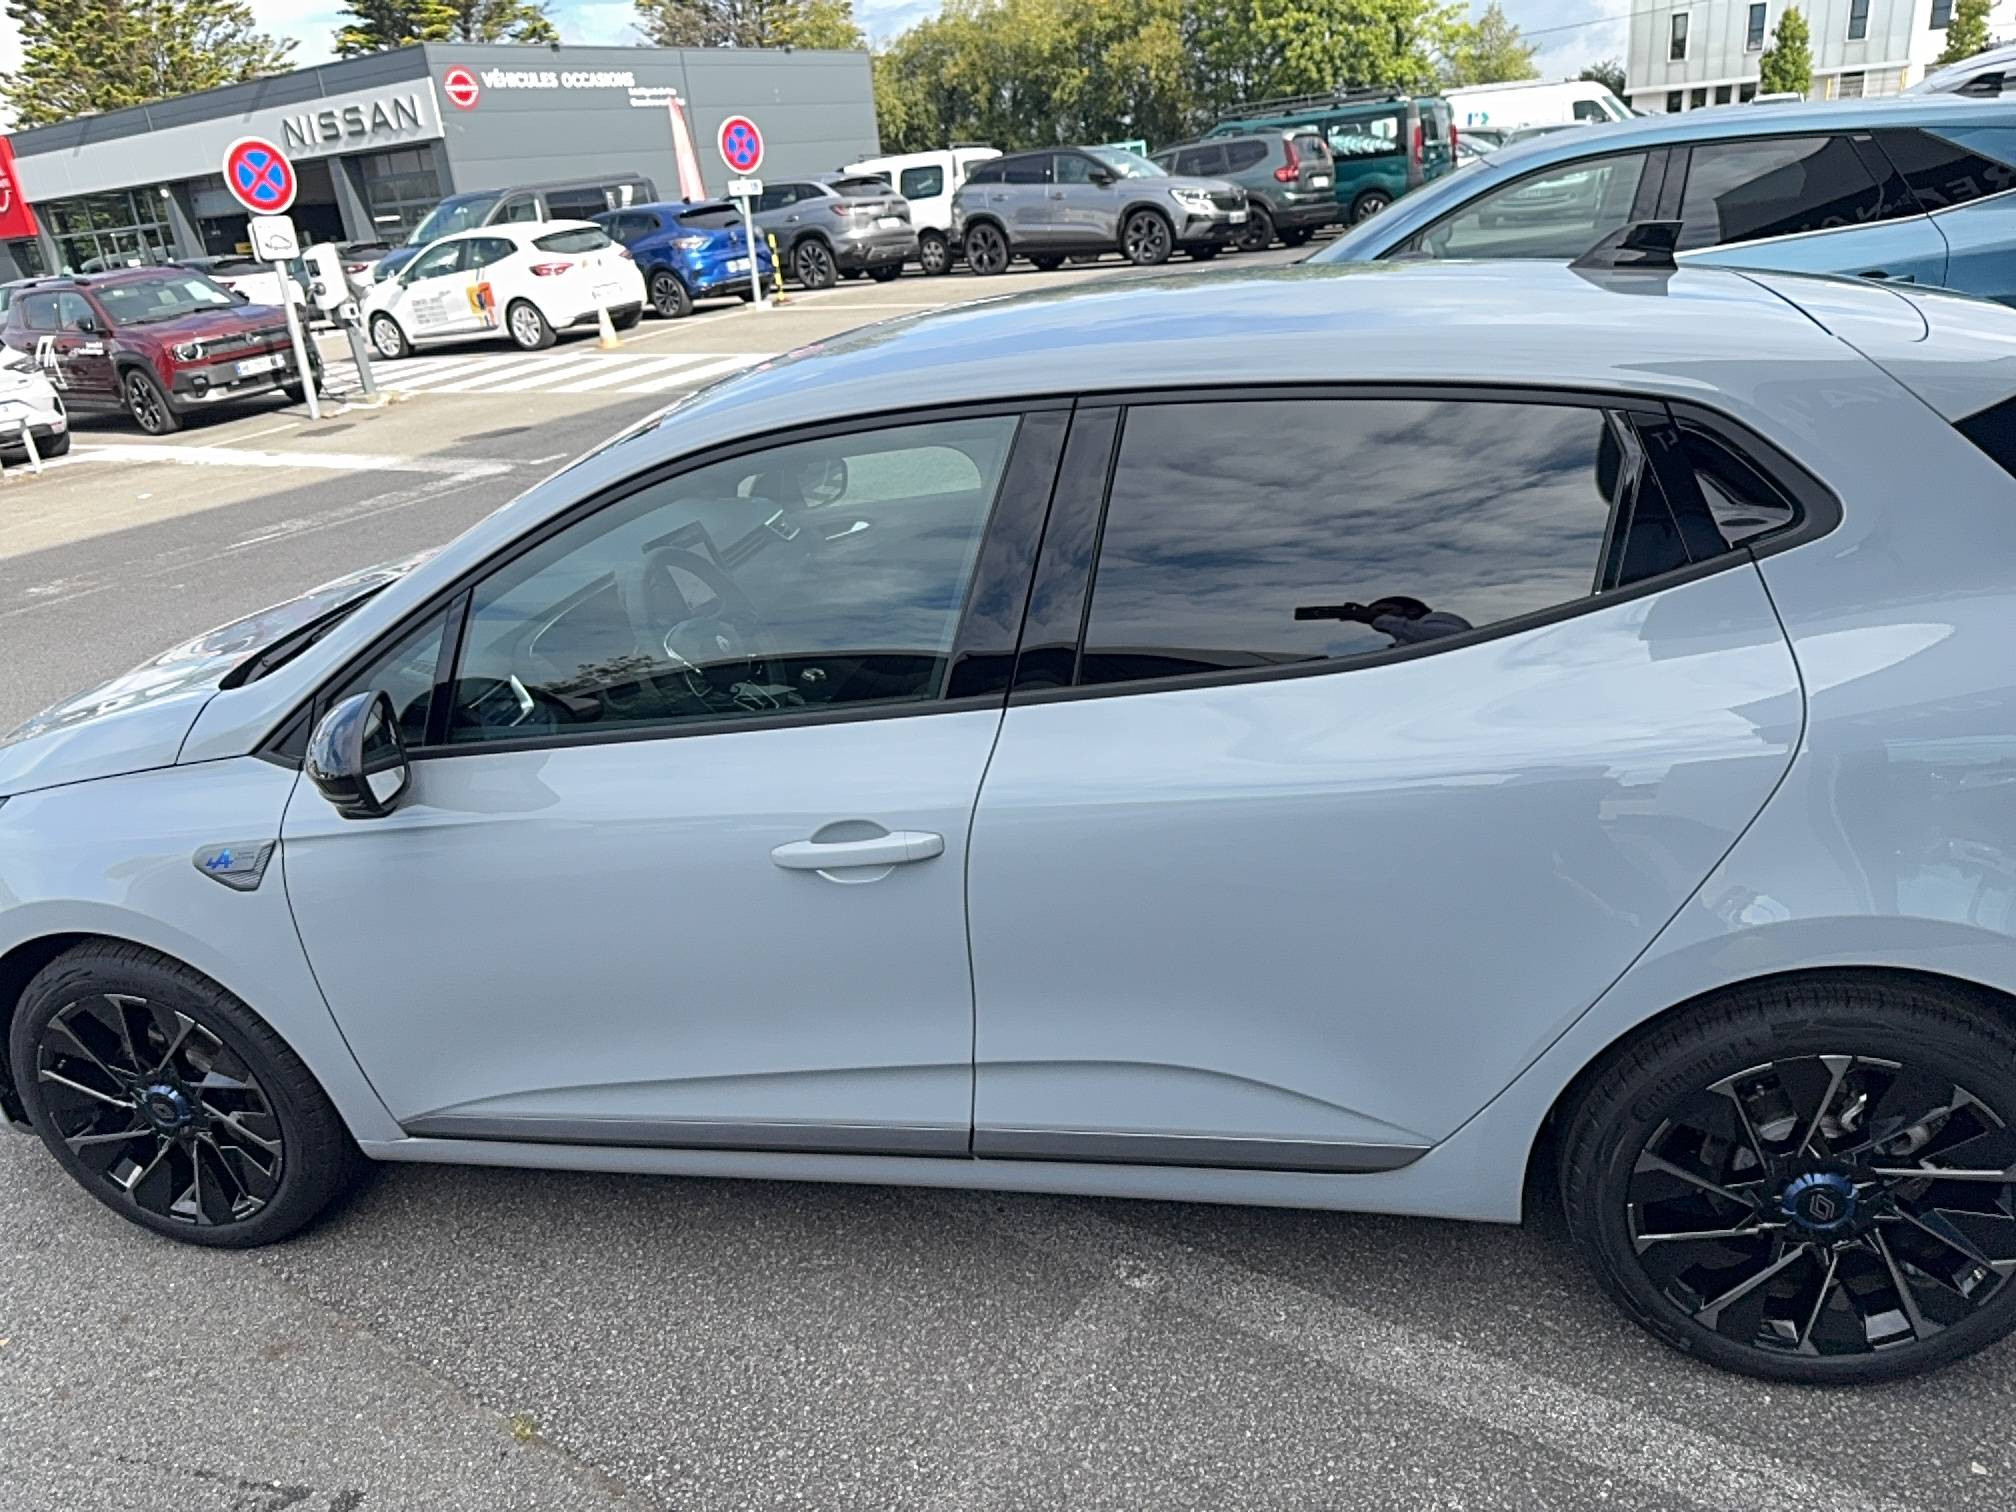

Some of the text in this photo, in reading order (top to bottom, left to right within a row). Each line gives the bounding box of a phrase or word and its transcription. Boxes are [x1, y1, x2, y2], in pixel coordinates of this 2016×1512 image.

[481, 67, 559, 88] VÉHICULES
[561, 71, 635, 88] OCCASIONS
[282, 94, 422, 147] NISSAN
